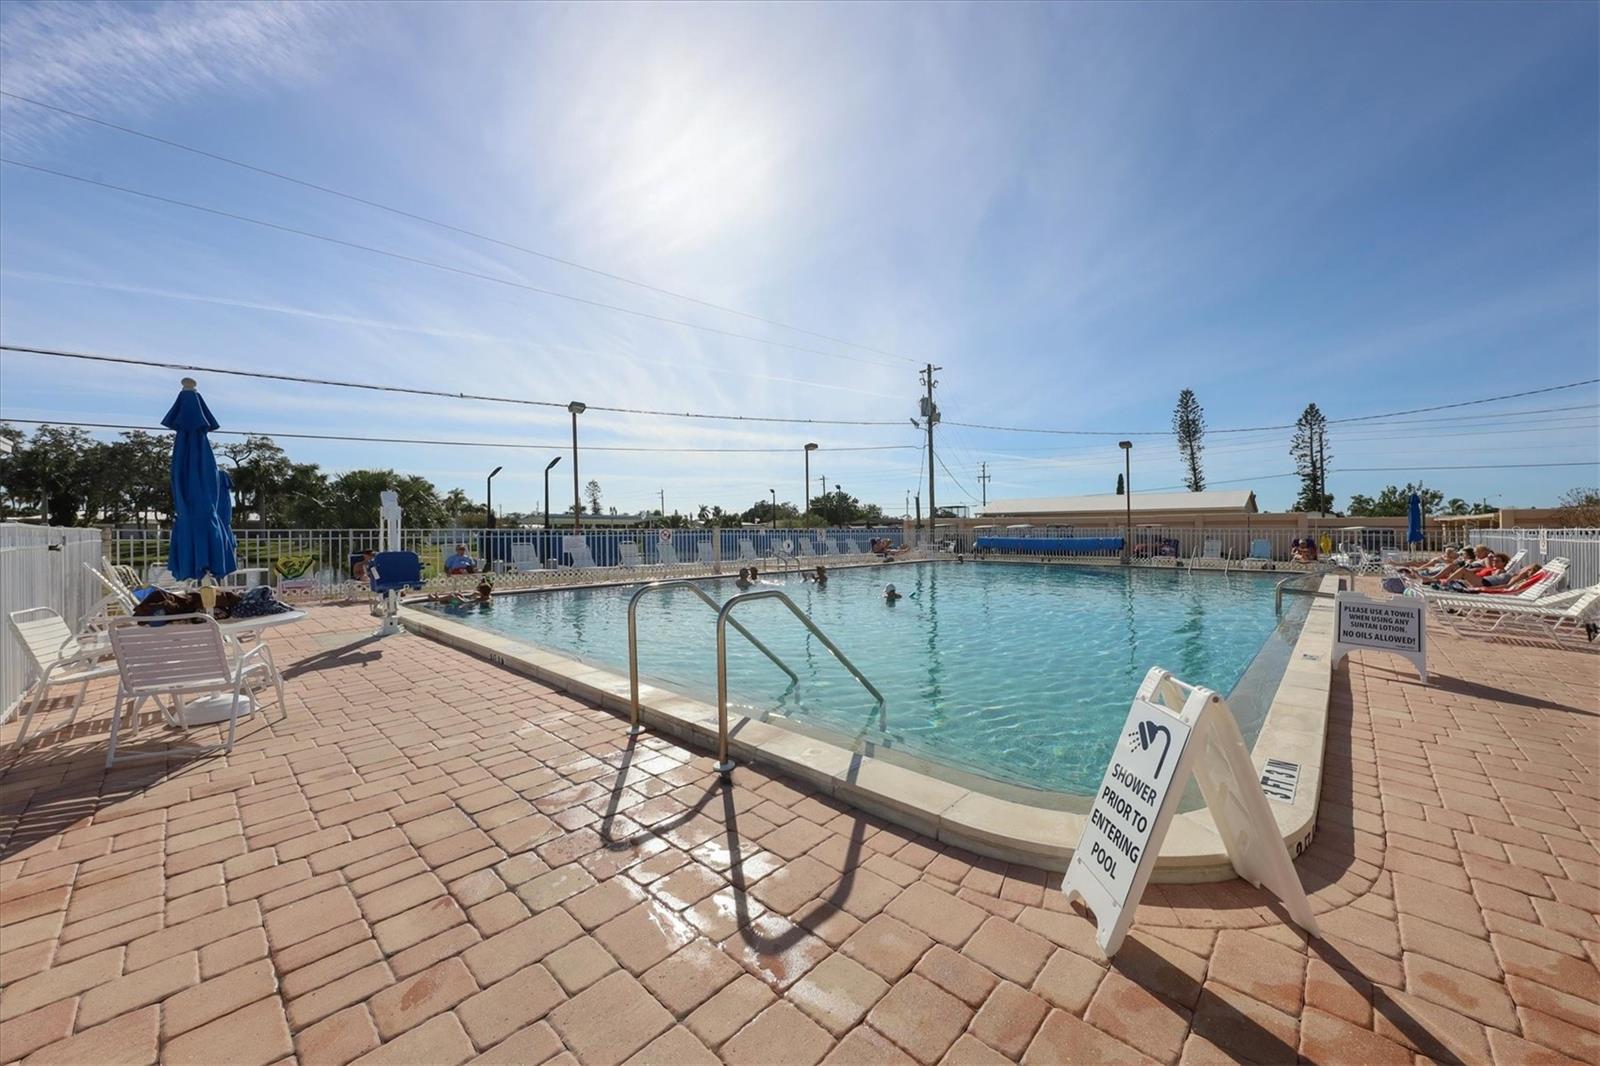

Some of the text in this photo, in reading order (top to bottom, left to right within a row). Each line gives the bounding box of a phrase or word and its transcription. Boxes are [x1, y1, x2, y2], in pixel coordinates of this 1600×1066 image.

[1344, 605, 1368, 614] PLEASE
[1369, 608, 1382, 616] USE
[1390, 610, 1415, 619] TOWEL
[1349, 613, 1410, 626] WHEN USING ANY
[1342, 630, 1416, 645] NO OILS ALLOWED!
[1350, 621, 1408, 633] SUNTAN LOTION.
[1112, 763, 1157, 807] SHOWER
[1101, 785, 1148, 833] PRIOR TO
[1091, 808, 1140, 864] ENTERING
[1090, 841, 1117, 880] POOL
